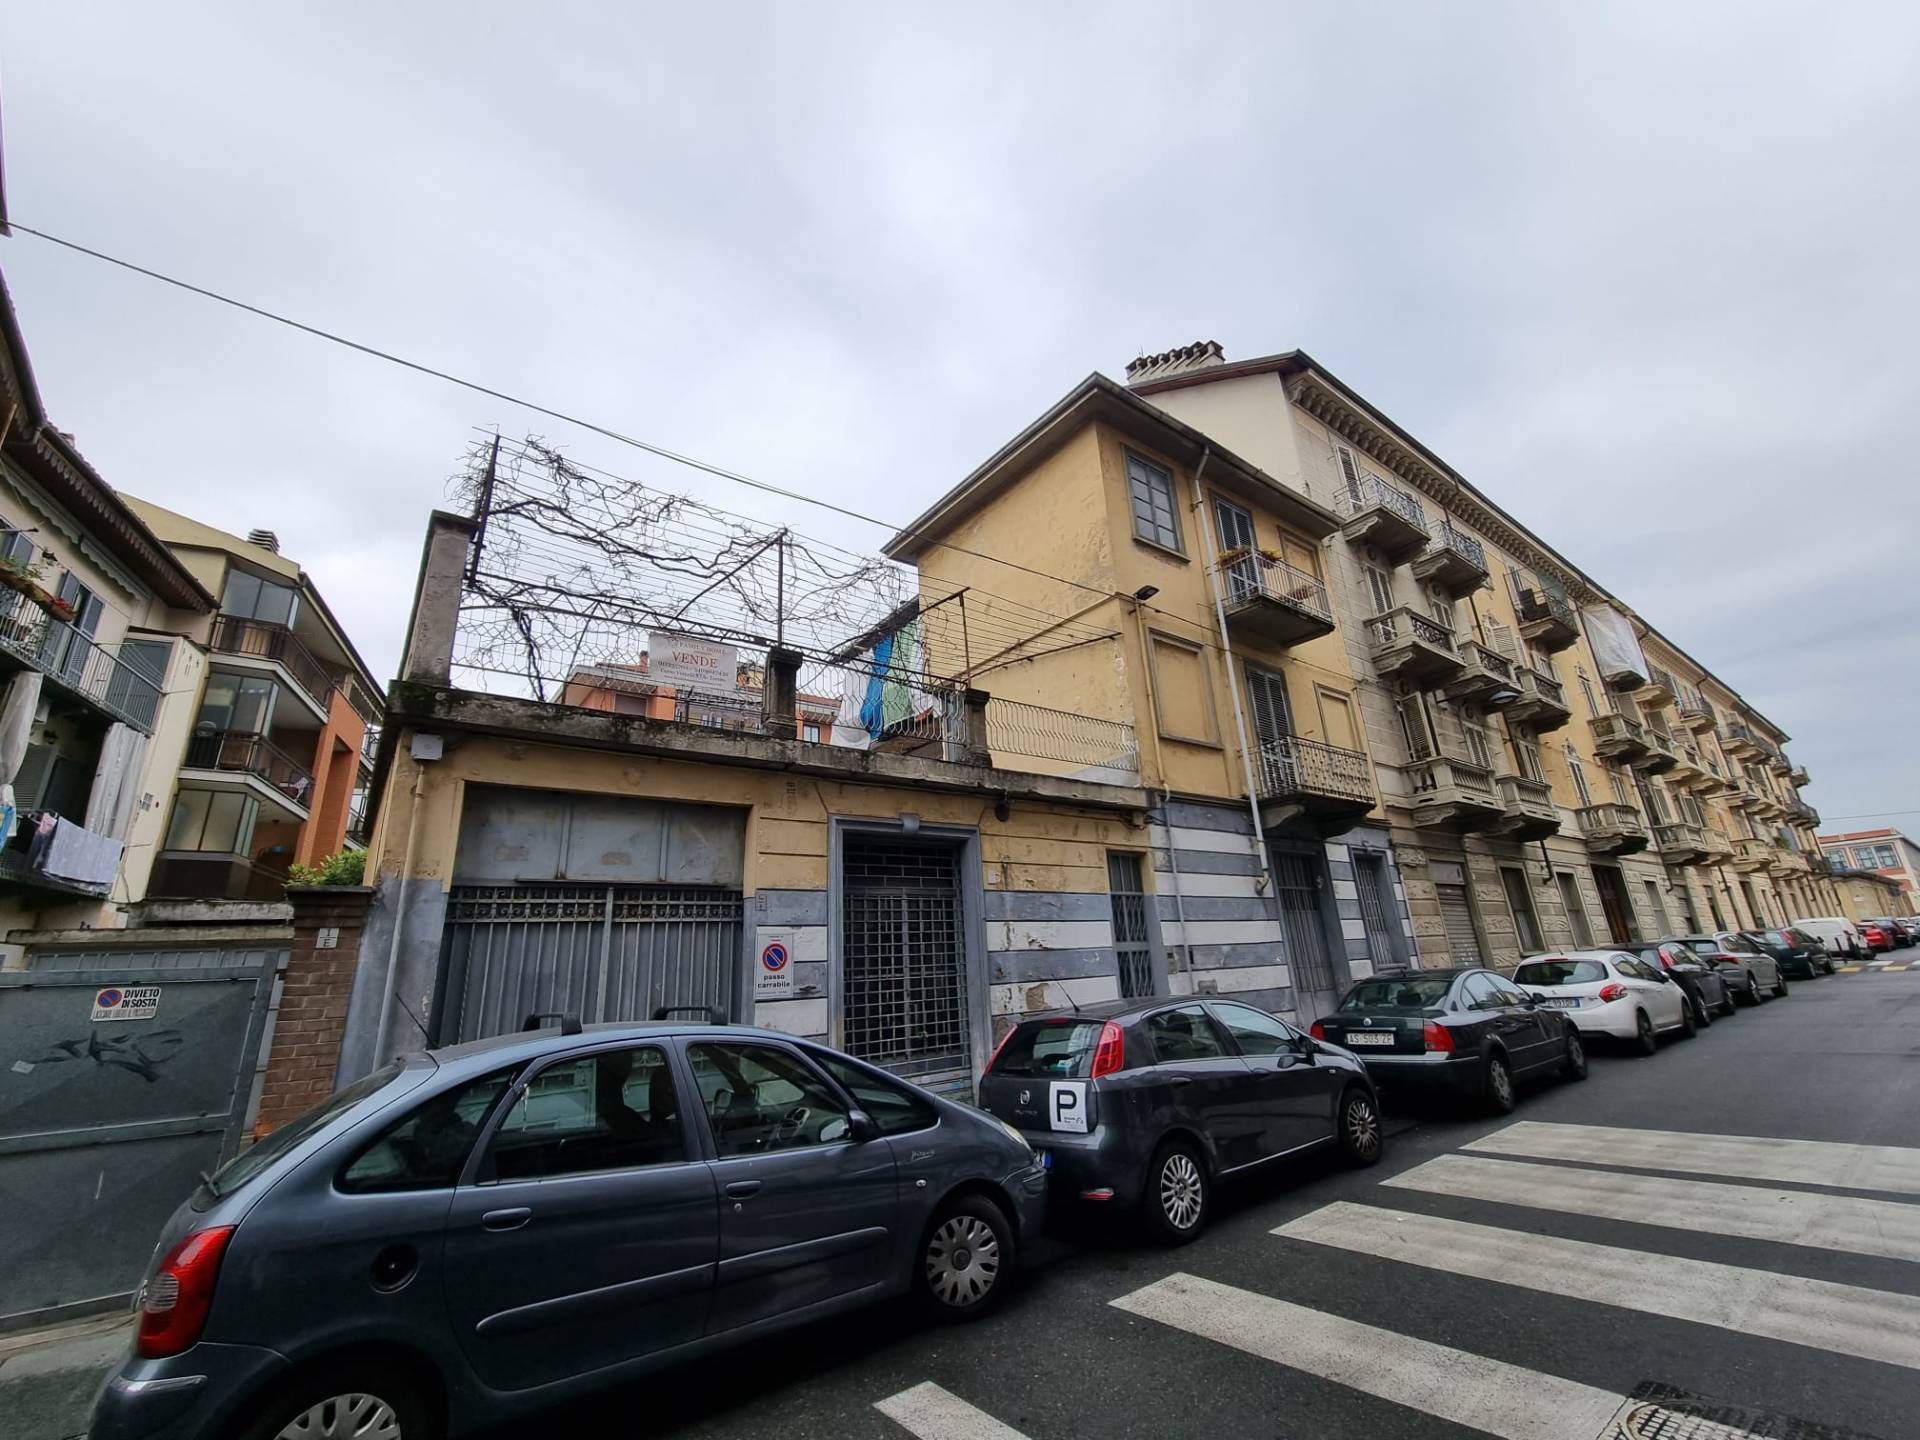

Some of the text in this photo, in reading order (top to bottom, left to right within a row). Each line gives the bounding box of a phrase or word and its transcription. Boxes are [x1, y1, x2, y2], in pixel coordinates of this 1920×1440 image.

[672, 651, 718, 669] VENDE
[758, 981, 790, 989] carrabile
[124, 988, 160, 999] DIVIETO
[121, 998, 157, 1008] DI SOSTA
[1056, 1089, 1077, 1122] P
